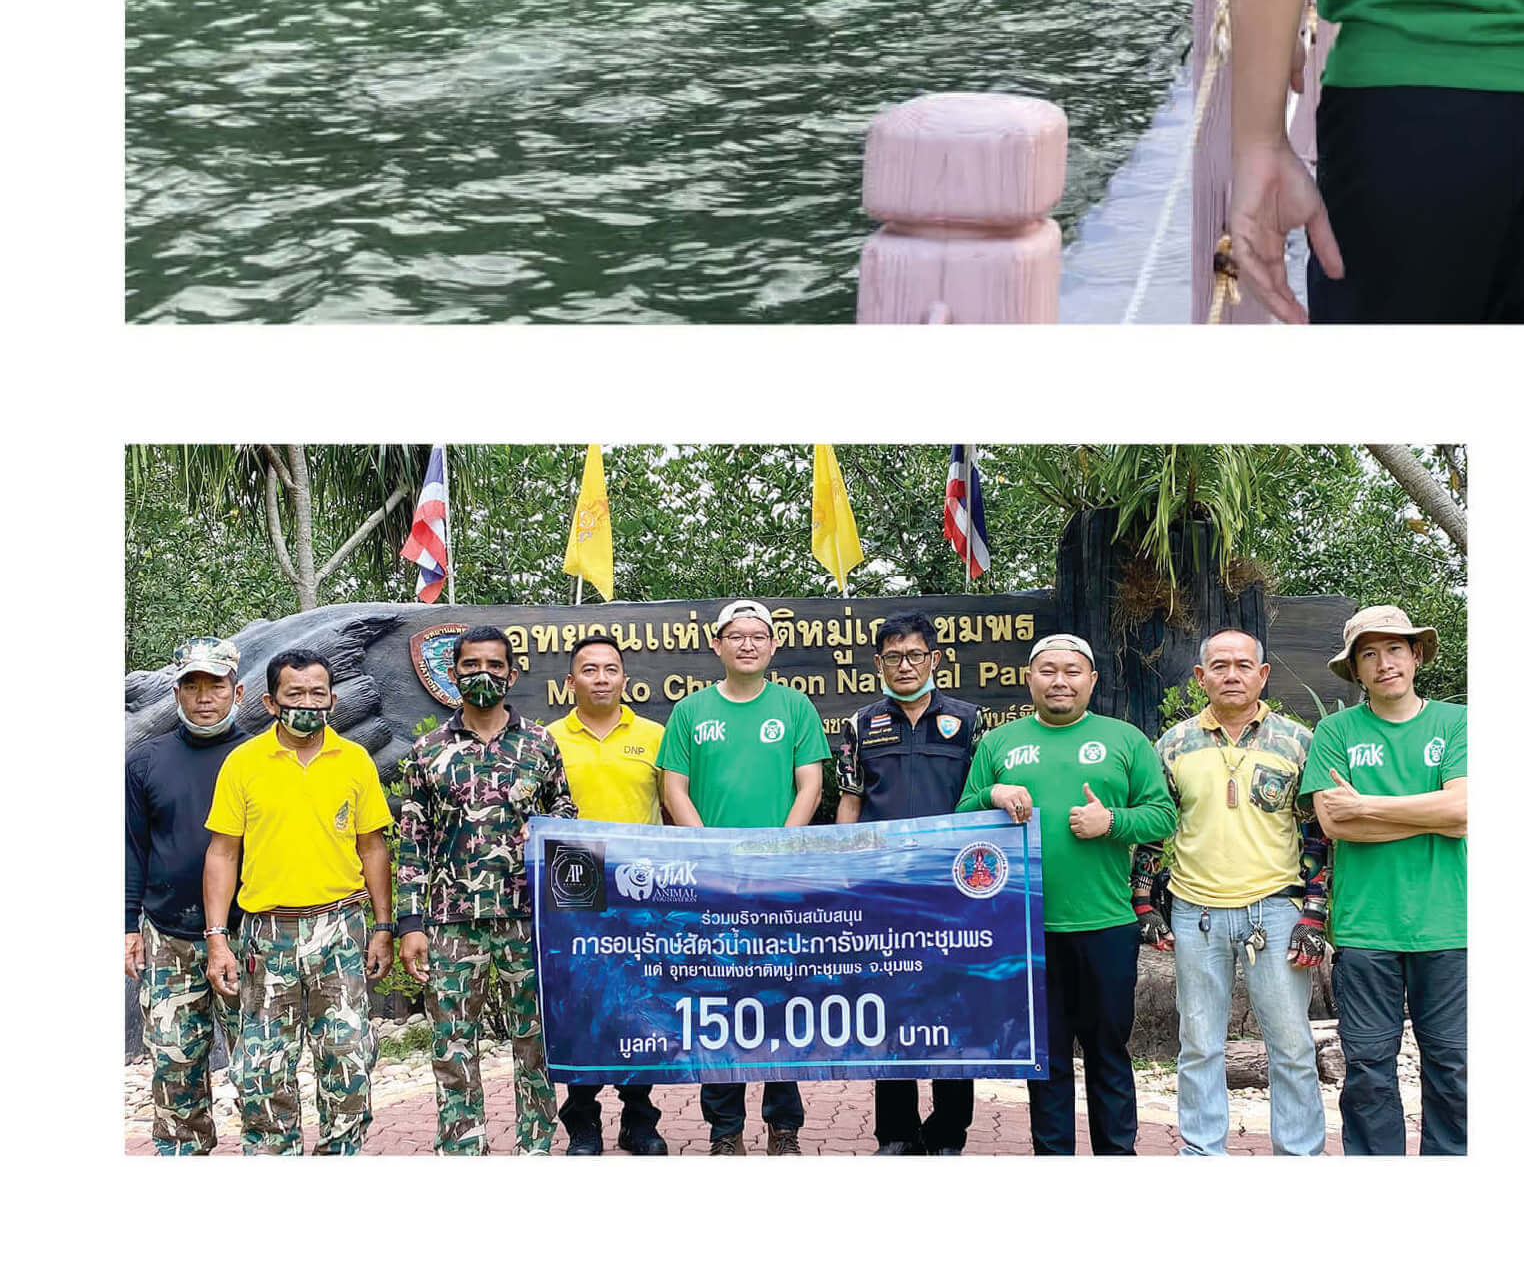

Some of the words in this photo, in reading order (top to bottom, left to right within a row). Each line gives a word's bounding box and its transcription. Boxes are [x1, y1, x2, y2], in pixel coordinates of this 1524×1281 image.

[546, 679, 576, 705] M
[979, 662, 1031, 688] Par
[623, 745, 645, 756] DNP
[565, 864, 584, 883] AP
[654, 888, 697, 898] ANIMAL
[701, 908, 863, 927] ร่วมบริจาคเงินสนับสนุน
[572, 927, 994, 962] การอนุรักษ์สัตว์น้ำและปะการังหมู่เกาะชุมพร
[644, 962, 663, 977] แด่
[669, 961, 863, 982] อุทยานแห่งชาติหมู่เกาะชุมพร
[869, 958, 924, 977] จ.ชุมพร
[619, 1032, 668, 1058] มูลค่า
[674, 992, 886, 1053] 150,000
[899, 1024, 949, 1047] บาท
